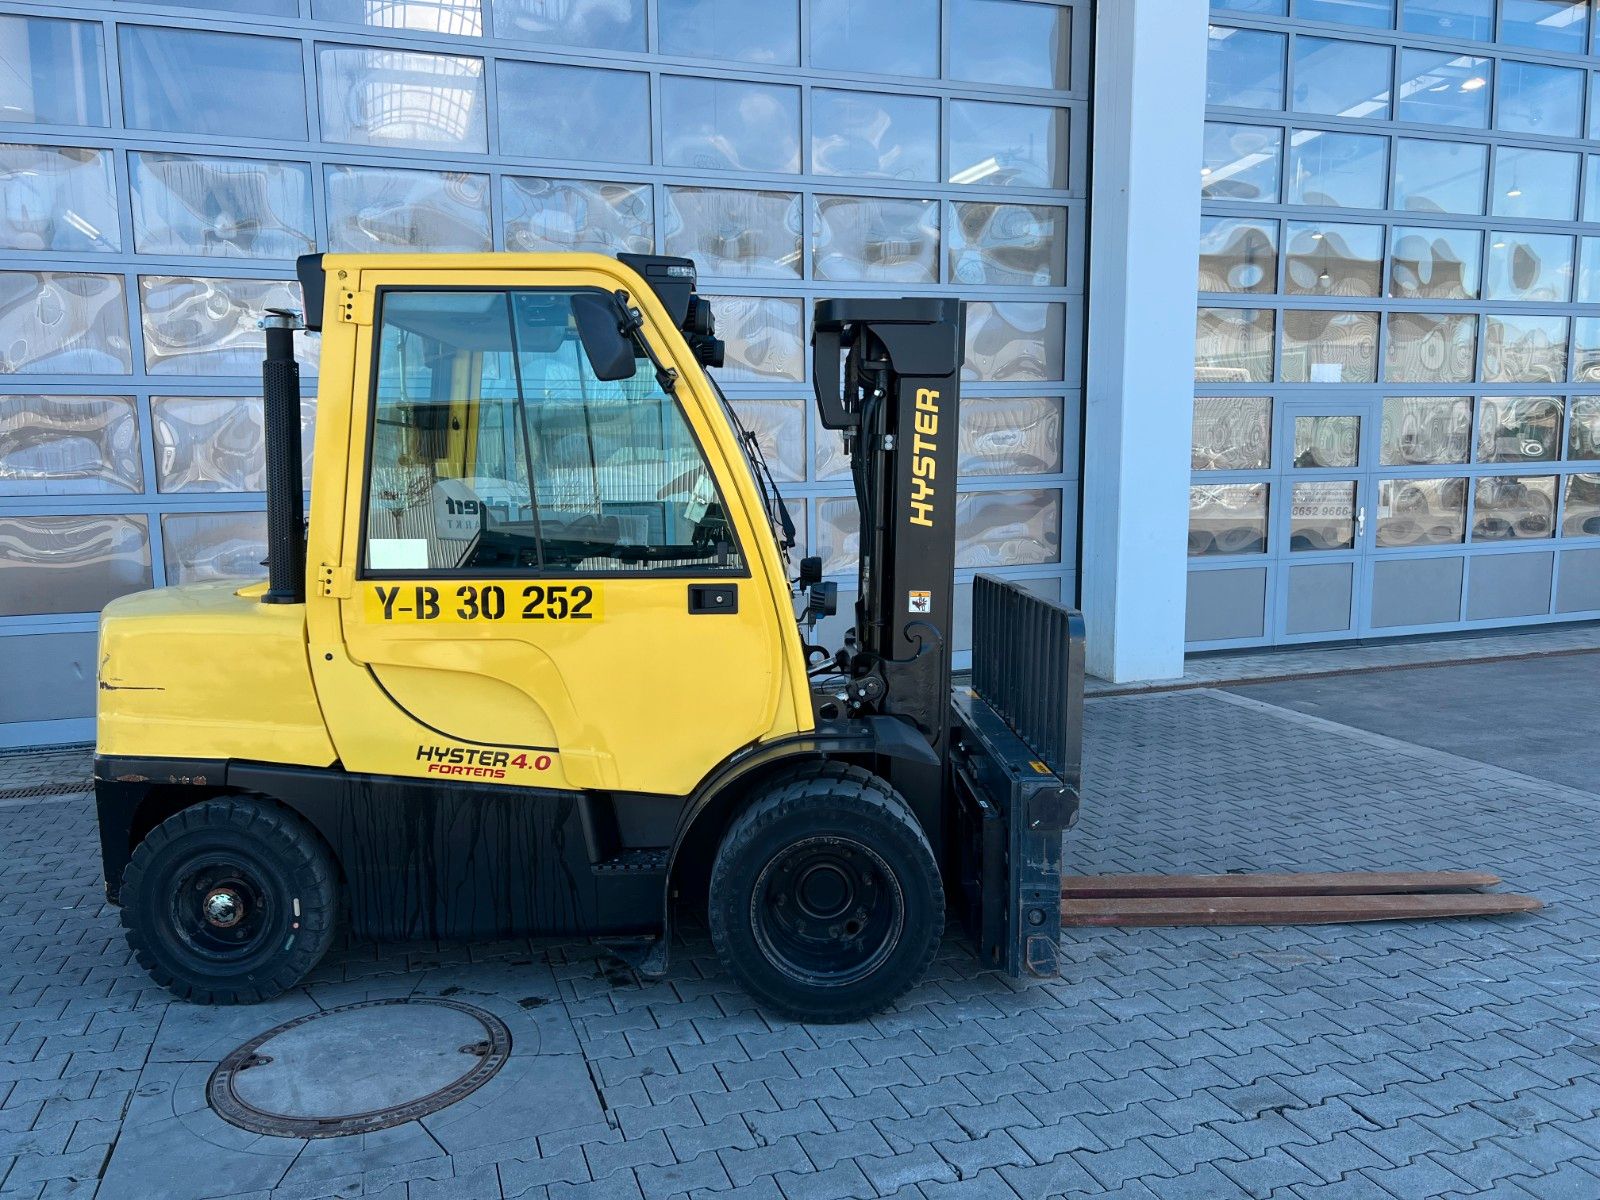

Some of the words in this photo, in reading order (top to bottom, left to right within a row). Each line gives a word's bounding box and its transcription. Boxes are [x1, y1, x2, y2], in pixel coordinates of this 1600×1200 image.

[910, 388, 940, 527] HYSTER
[374, 586, 441, 620] Y-B
[456, 586, 505, 620] 30
[522, 586, 593, 620] 252
[416, 745, 510, 767] HYSTER
[511, 753, 552, 771] 4.0
[428, 764, 506, 778] FORTENS
